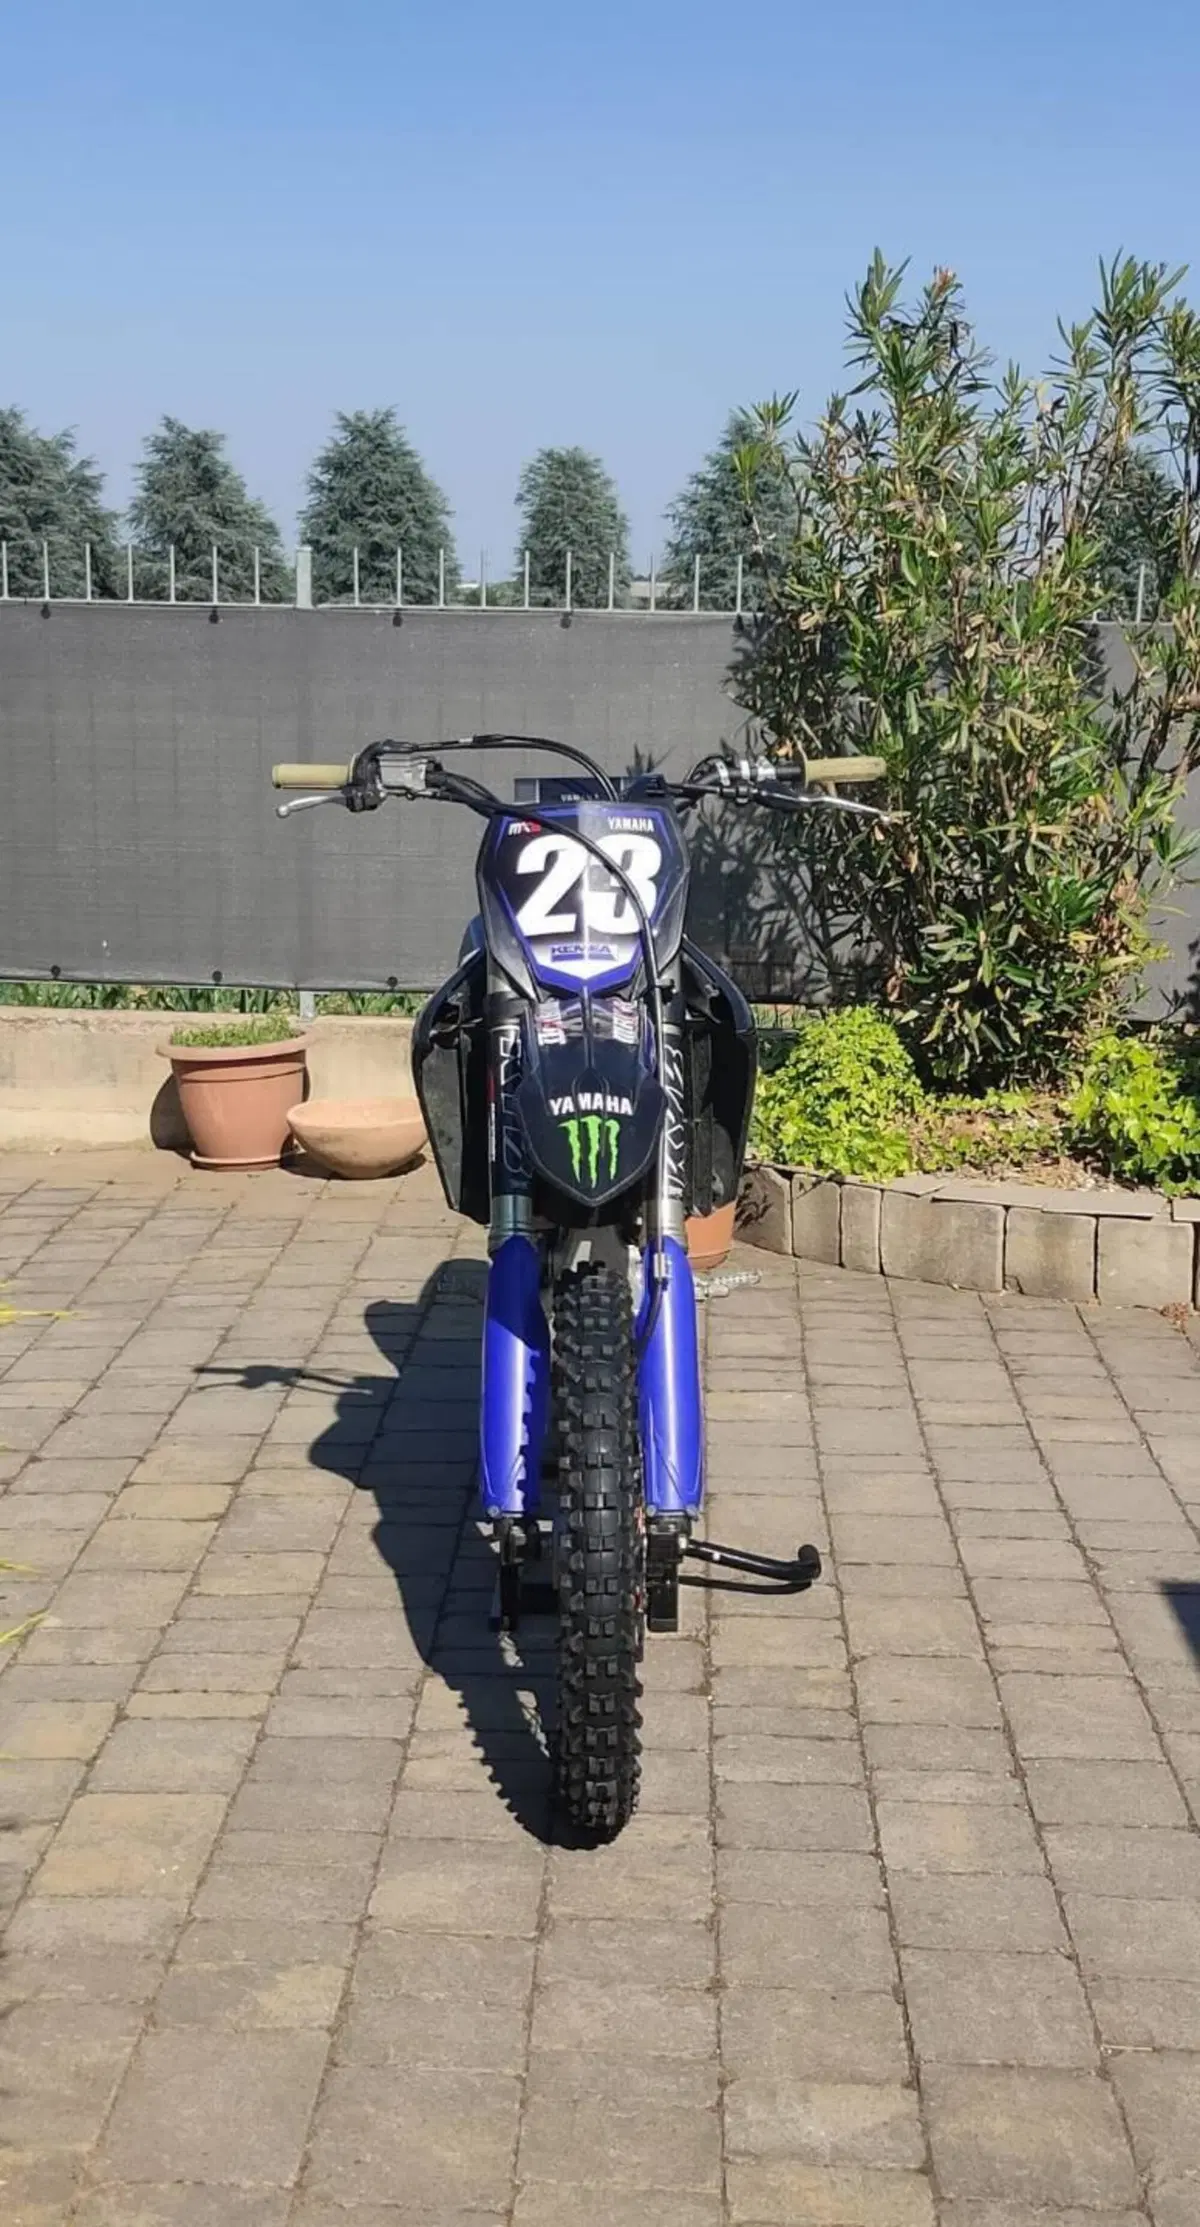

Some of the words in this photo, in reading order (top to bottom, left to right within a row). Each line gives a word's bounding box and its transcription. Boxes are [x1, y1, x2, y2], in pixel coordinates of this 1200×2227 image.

[607, 816, 655, 832] YAMAHA
[516, 833, 662, 937] 23
[549, 1092, 634, 1116] YAMAHA
